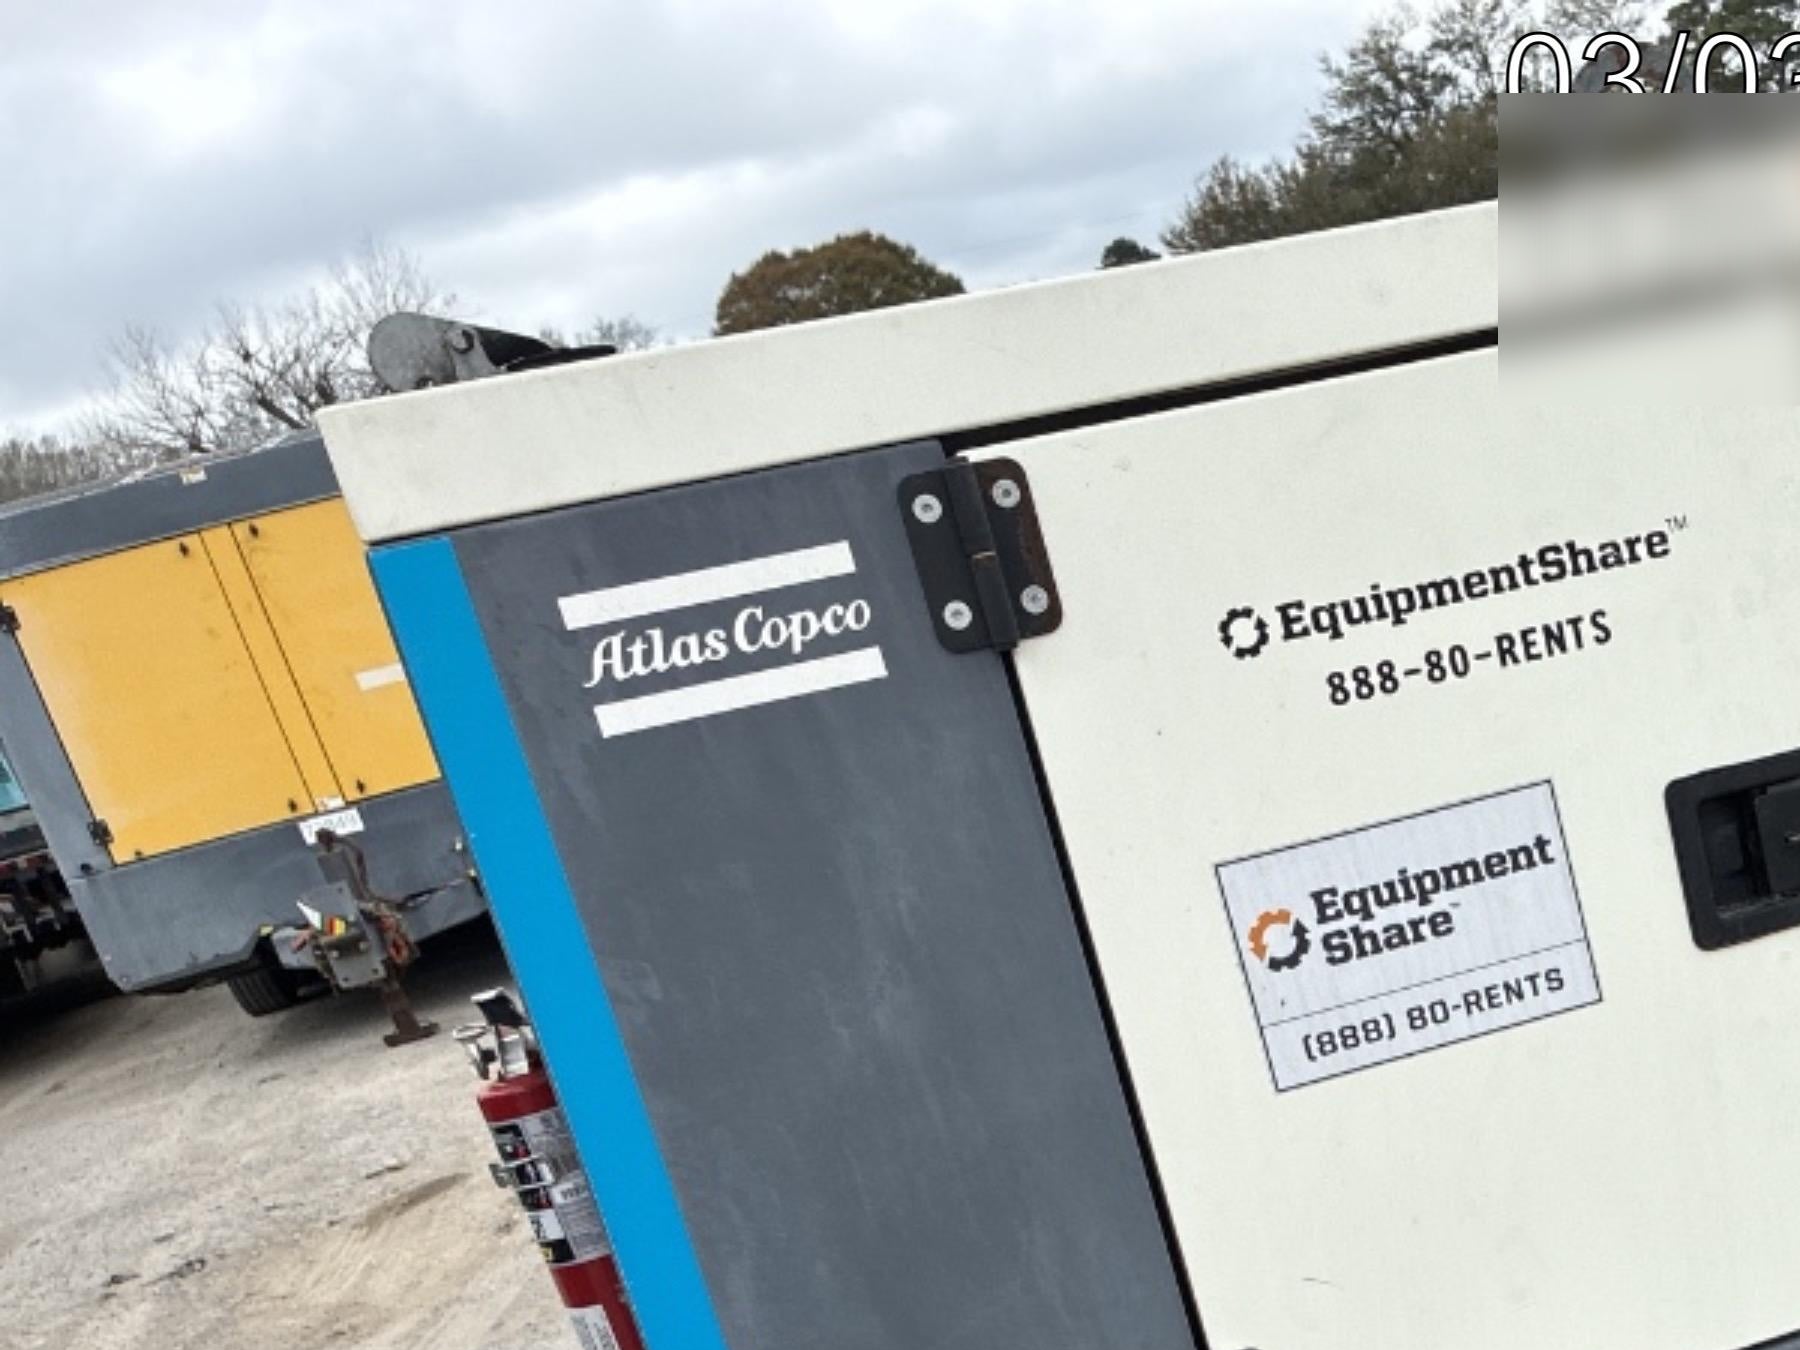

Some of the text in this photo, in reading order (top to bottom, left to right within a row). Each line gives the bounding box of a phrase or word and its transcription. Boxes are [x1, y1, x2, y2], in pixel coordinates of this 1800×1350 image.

[584, 599, 871, 689] Atlas Copco
[1325, 608, 1612, 706] 888-80-RENTS
[1310, 833, 1555, 926] Equipment
[1302, 967, 1565, 1062] (888) 80-RENTS
